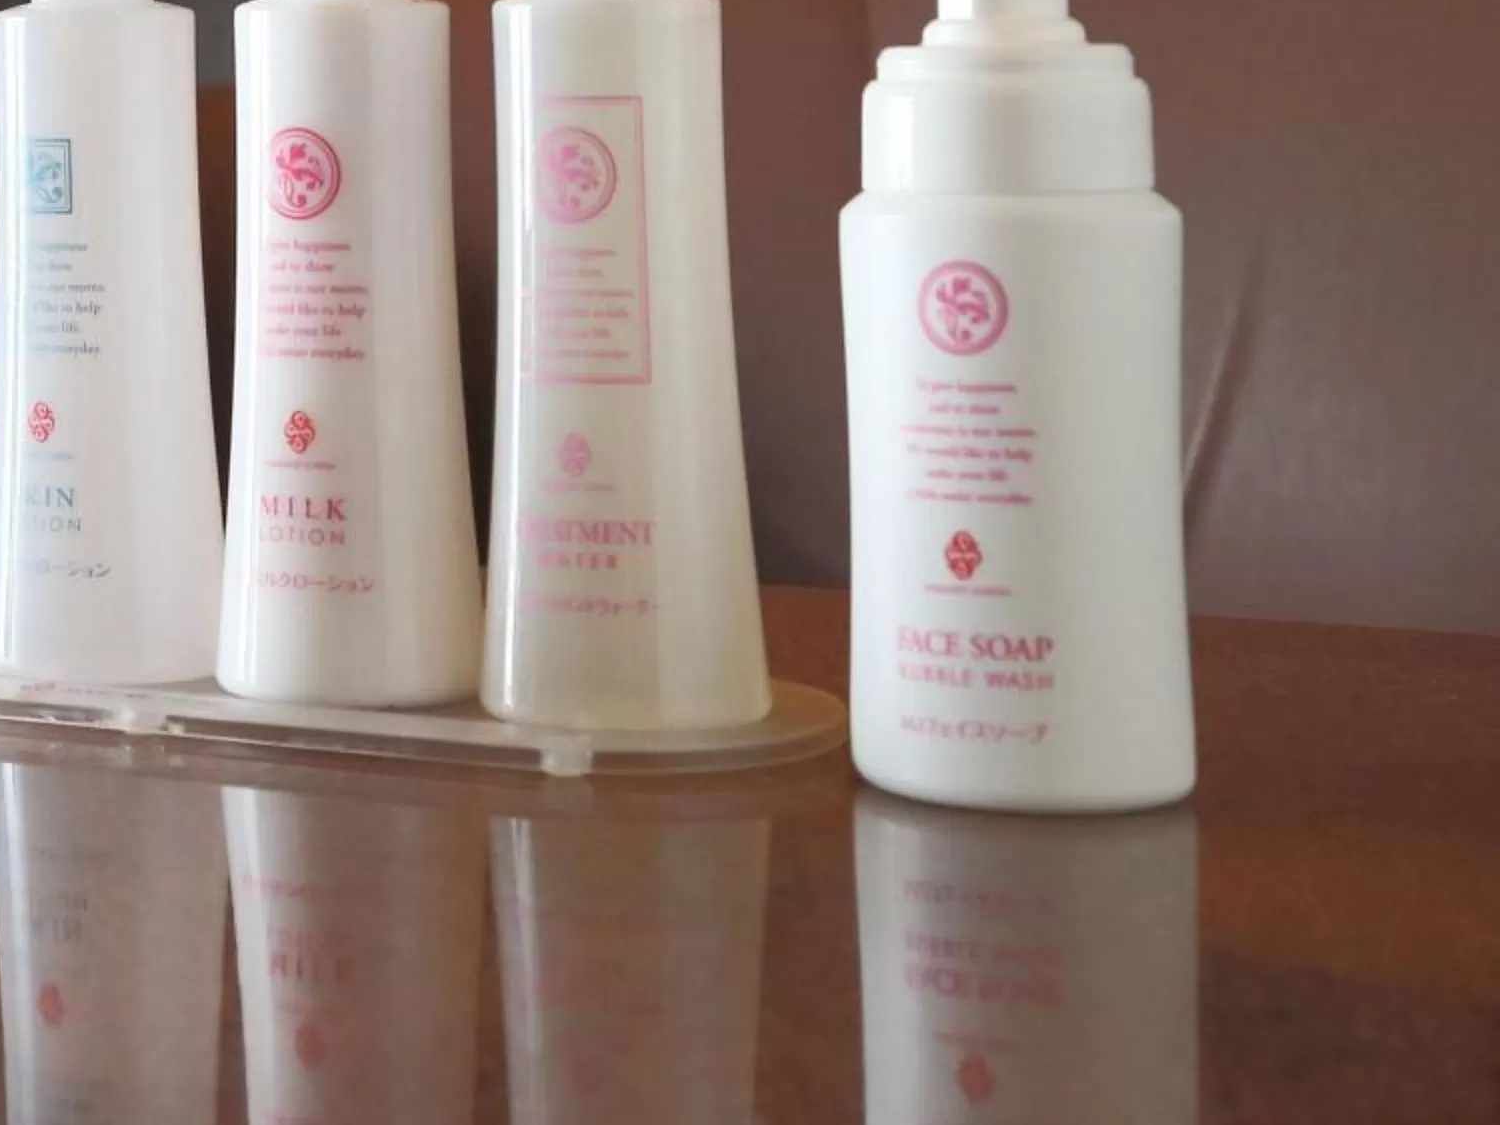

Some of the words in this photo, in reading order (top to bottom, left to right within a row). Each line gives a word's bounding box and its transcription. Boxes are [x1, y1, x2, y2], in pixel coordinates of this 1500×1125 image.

[260, 495, 347, 521] MILK
[897, 626, 960, 658] FACE
[970, 632, 1056, 663] SOAP
